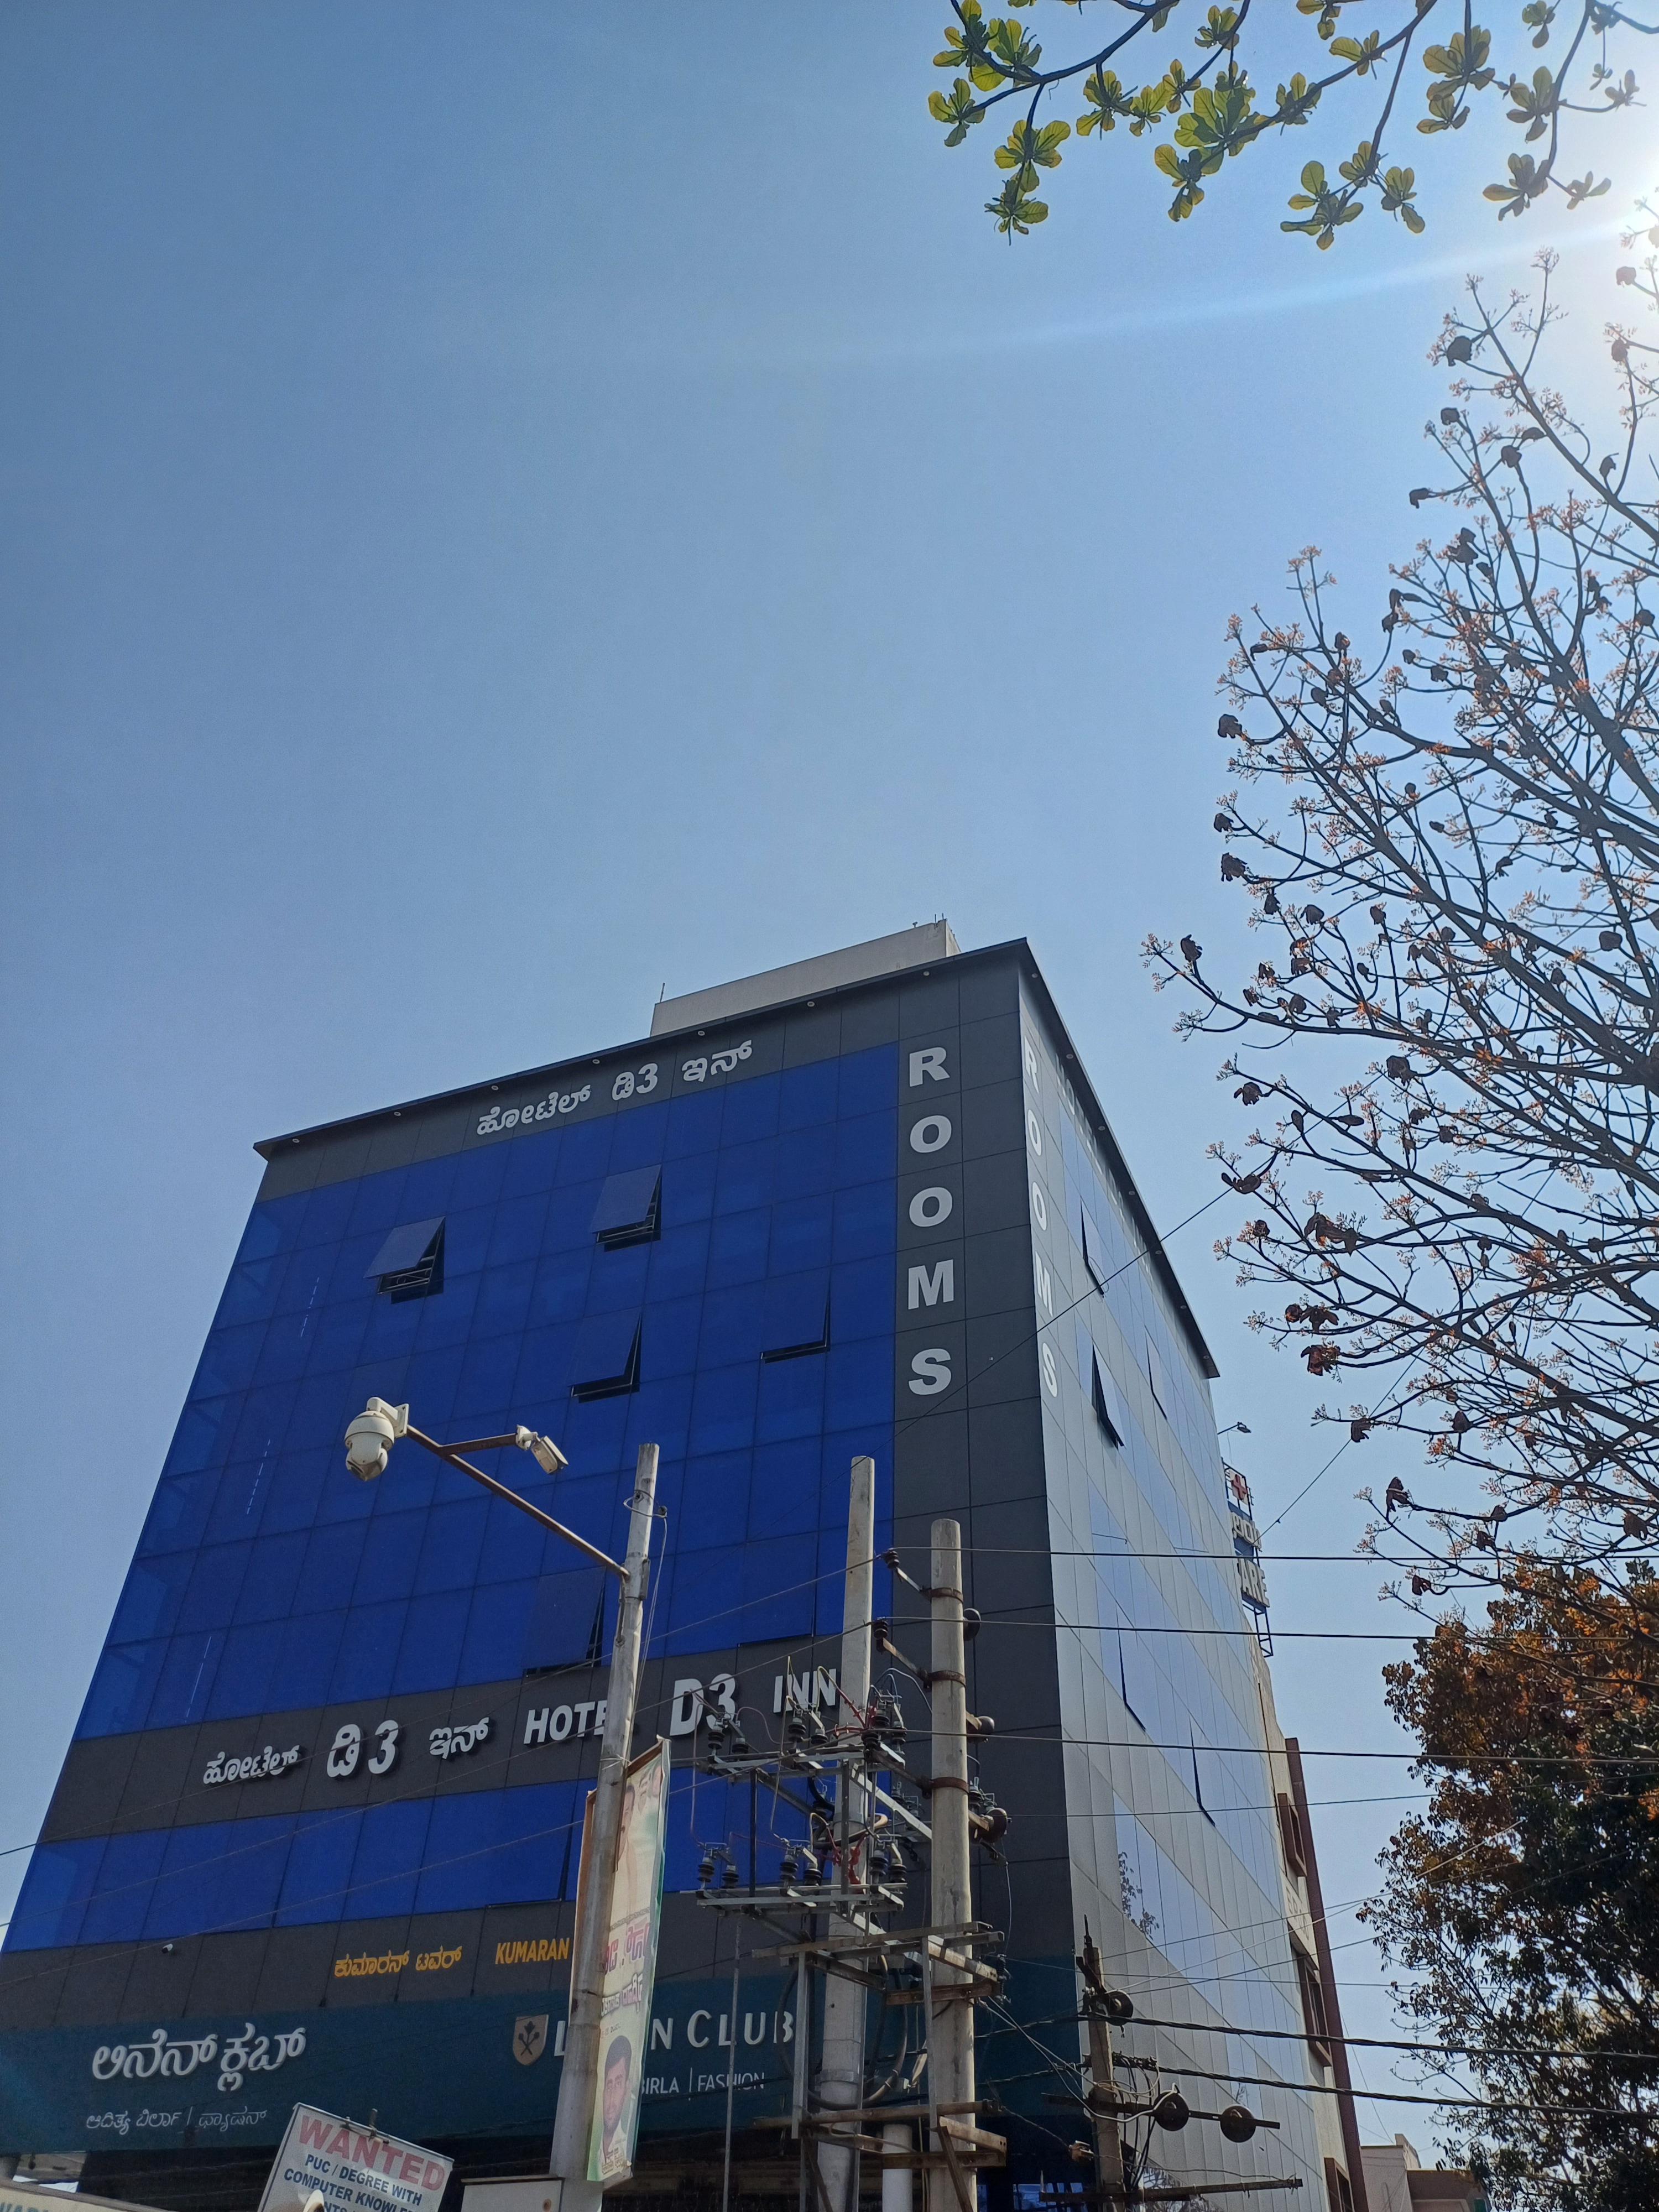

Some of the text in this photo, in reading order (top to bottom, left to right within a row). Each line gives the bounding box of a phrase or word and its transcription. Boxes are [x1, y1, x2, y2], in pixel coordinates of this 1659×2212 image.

[477, 1040, 753, 1135] ಹೋಟೆಲ್ ಡಿ3 ಇನ್
[908, 1047, 954, 1395] ROOMS
[1024, 1035, 1058, 1397] ROOMS
[1238, 1556, 1270, 1608] ARE
[524, 1668, 837, 1744] HOTE D3 INN
[203, 1745, 300, 1784] ಹೋಟೆಲ್
[429, 1717, 489, 1760] ಇನ್
[334, 1945, 462, 1978] ಕುಮಾರನ್ ಟವರ್
[495, 1937, 570, 1965] KUMARAN
[687, 2010, 794, 2048] CLUB
[92, 2022, 306, 2091] ಲಿನೆನ್ ಕ್ಲಬ್
[698, 2072, 764, 2091] FASHION
[86, 2110, 131, 2135] ಆದಿತ್ಯ
[299, 2114, 446, 2192] WANTED
[284, 2168, 353, 2202] COMPUTER
[305, 2154, 331, 2173] PUC
[339, 2166, 389, 2193] DEGREE
[392, 2184, 422, 2206] WITH
